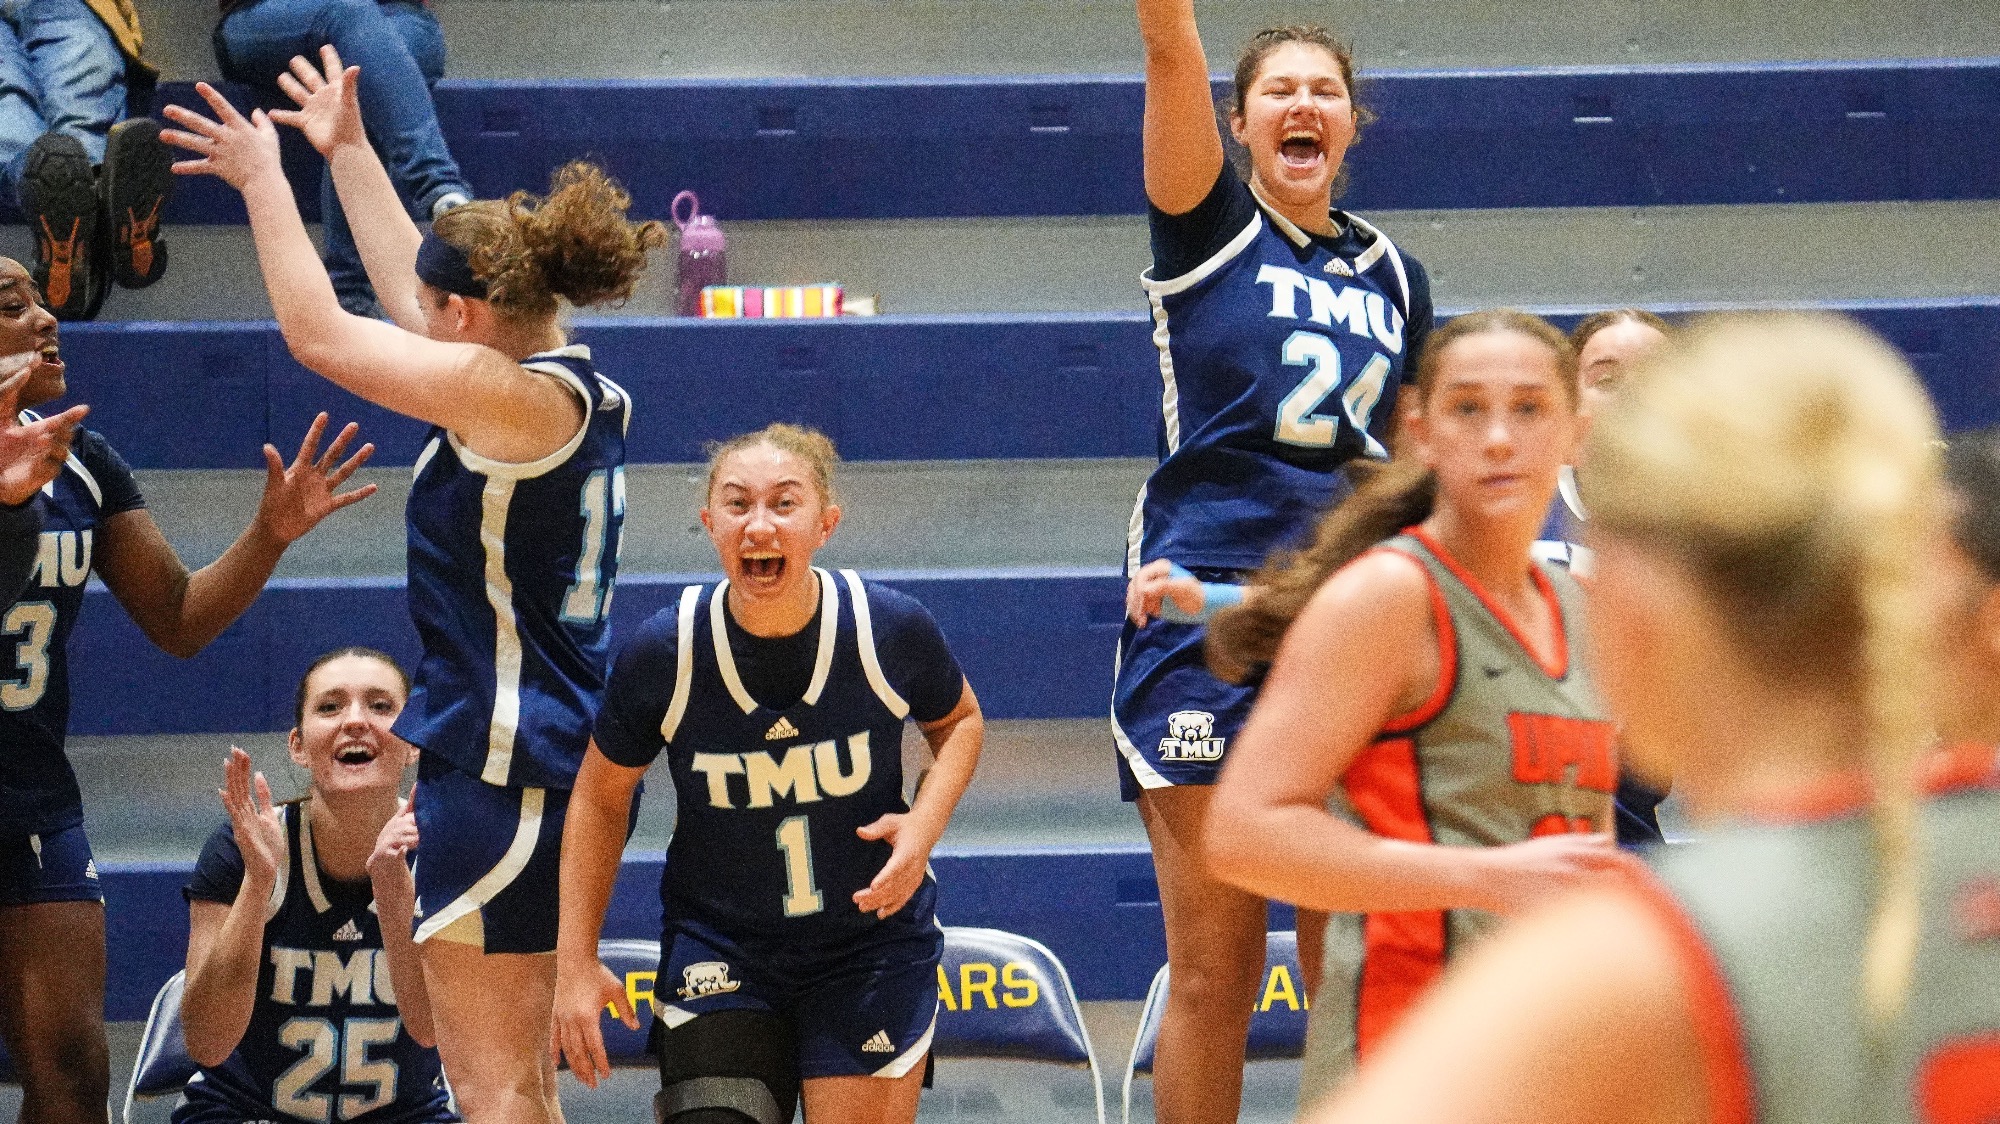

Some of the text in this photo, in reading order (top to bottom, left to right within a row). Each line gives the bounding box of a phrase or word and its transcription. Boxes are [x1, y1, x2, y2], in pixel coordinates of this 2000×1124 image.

[1255, 264, 1405, 355] TMU
[1273, 330, 1389, 459] 24
[30, 529, 93, 588] MU
[0, 600, 58, 711] 3
[691, 729, 872, 810] TMU
[765, 728, 799, 741] adidas
[1158, 738, 1226, 761] TMU
[775, 815, 824, 918] 1
[936, 962, 1039, 1012] ARS
[271, 1016, 402, 1124] 25
[861, 1043, 895, 1053] adidas
